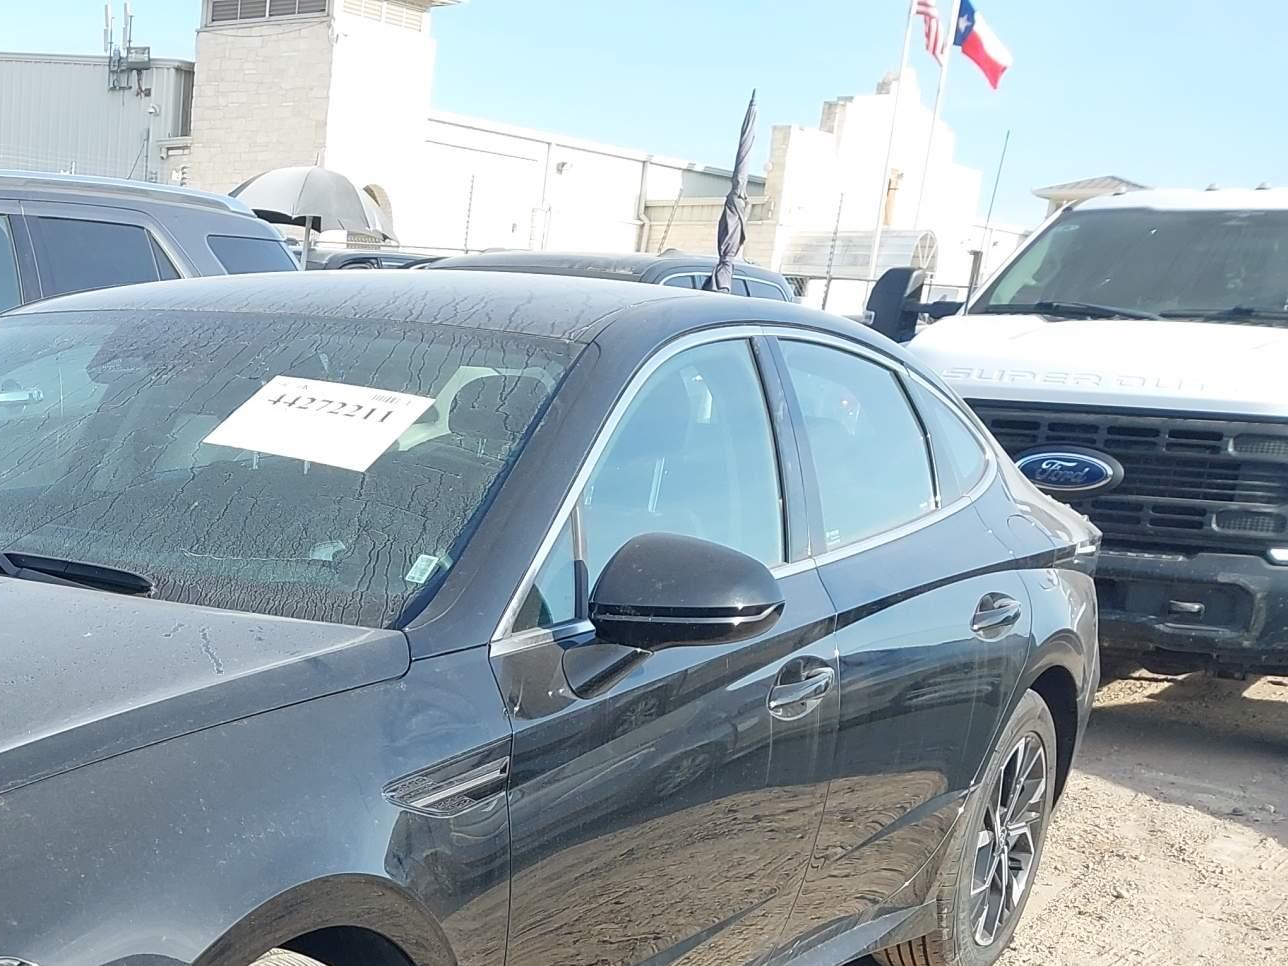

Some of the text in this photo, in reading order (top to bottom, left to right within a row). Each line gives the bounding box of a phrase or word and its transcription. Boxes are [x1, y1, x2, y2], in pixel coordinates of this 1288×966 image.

[942, 367, 1102, 387] SUPER
[267, 392, 395, 423] 44272211
[1036, 459, 1090, 482] Ford
